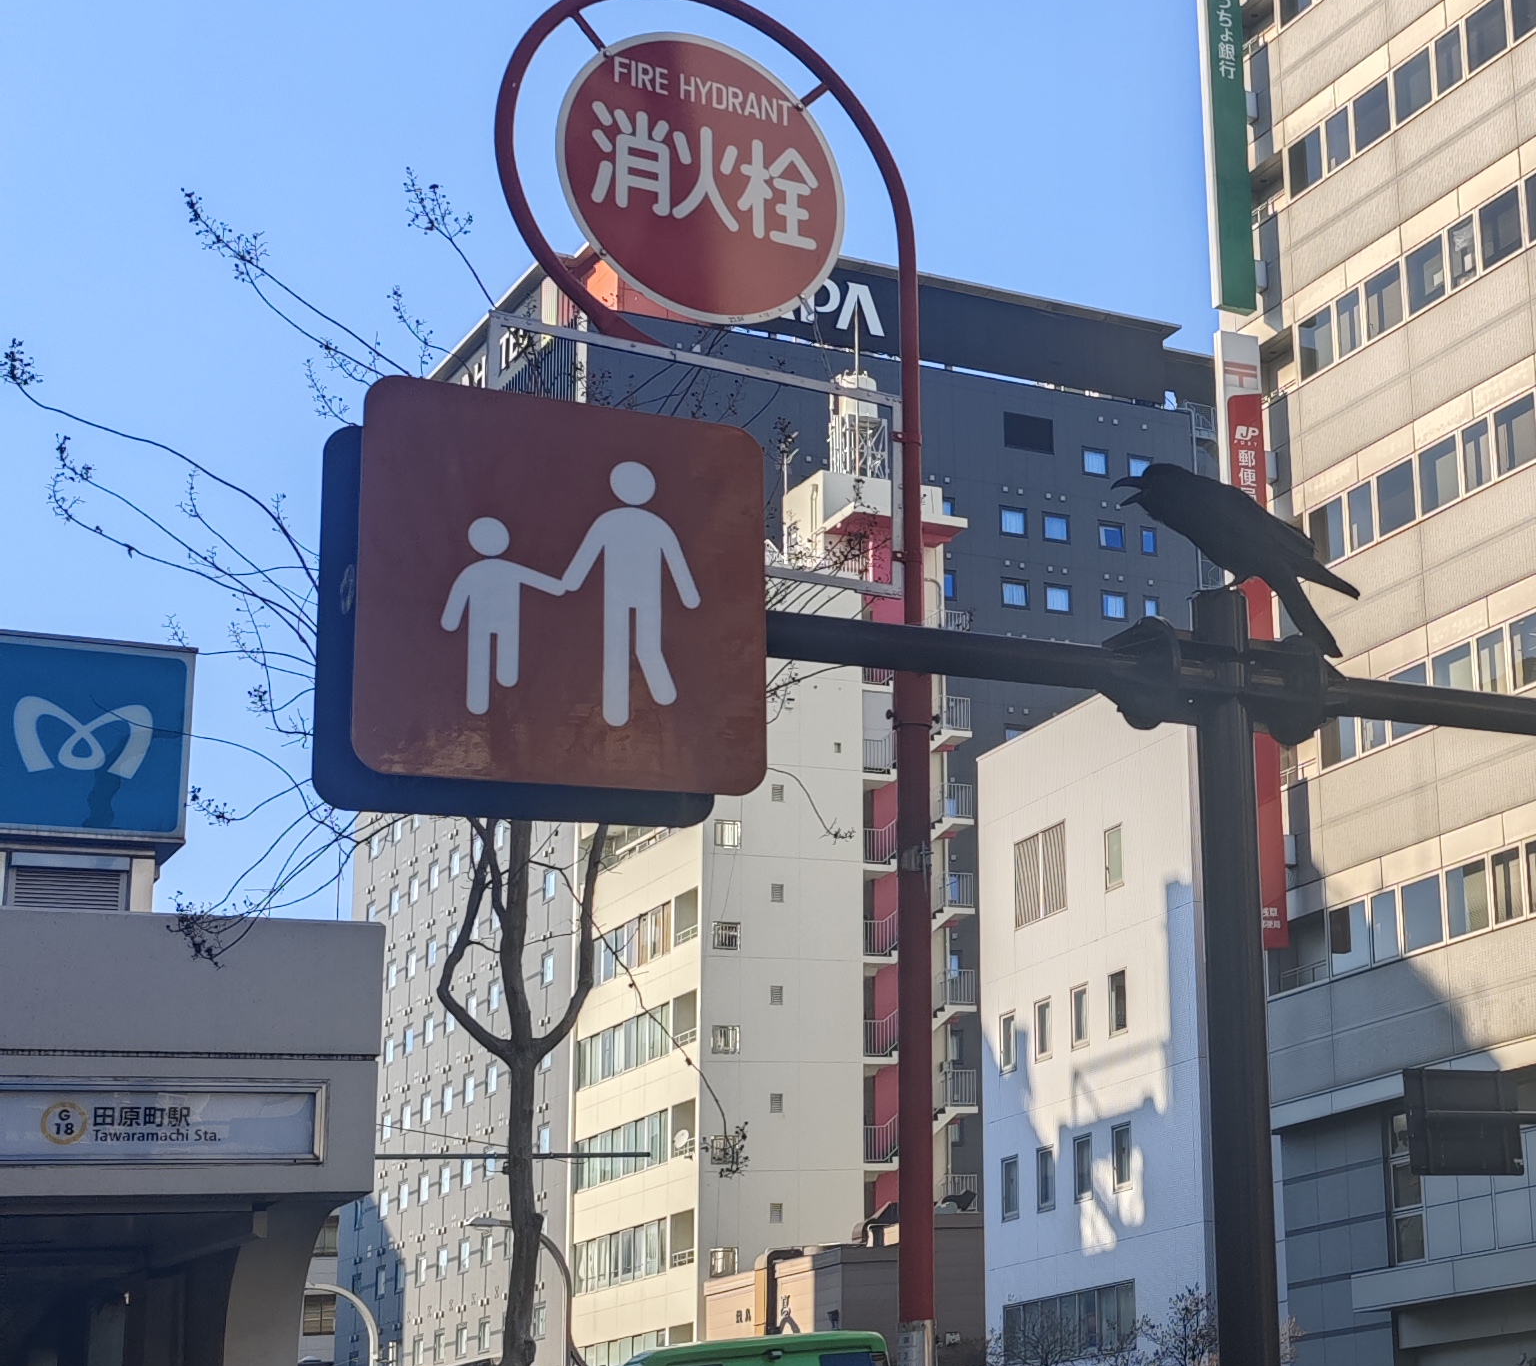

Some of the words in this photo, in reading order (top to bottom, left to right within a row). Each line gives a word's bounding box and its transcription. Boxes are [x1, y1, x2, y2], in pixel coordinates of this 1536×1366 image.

[613, 56, 670, 96] FIRE
[679, 73, 794, 127] HYDRANT
[591, 100, 820, 252] 消火栓
[780, 278, 886, 337] PA
[58, 1109, 71, 1122] G
[92, 1106, 191, 1128] 田原町駅
[54, 1122, 75, 1136] 18
[92, 1129, 190, 1143] Tawaramachi
[194, 1129, 222, 1143] Sta.
